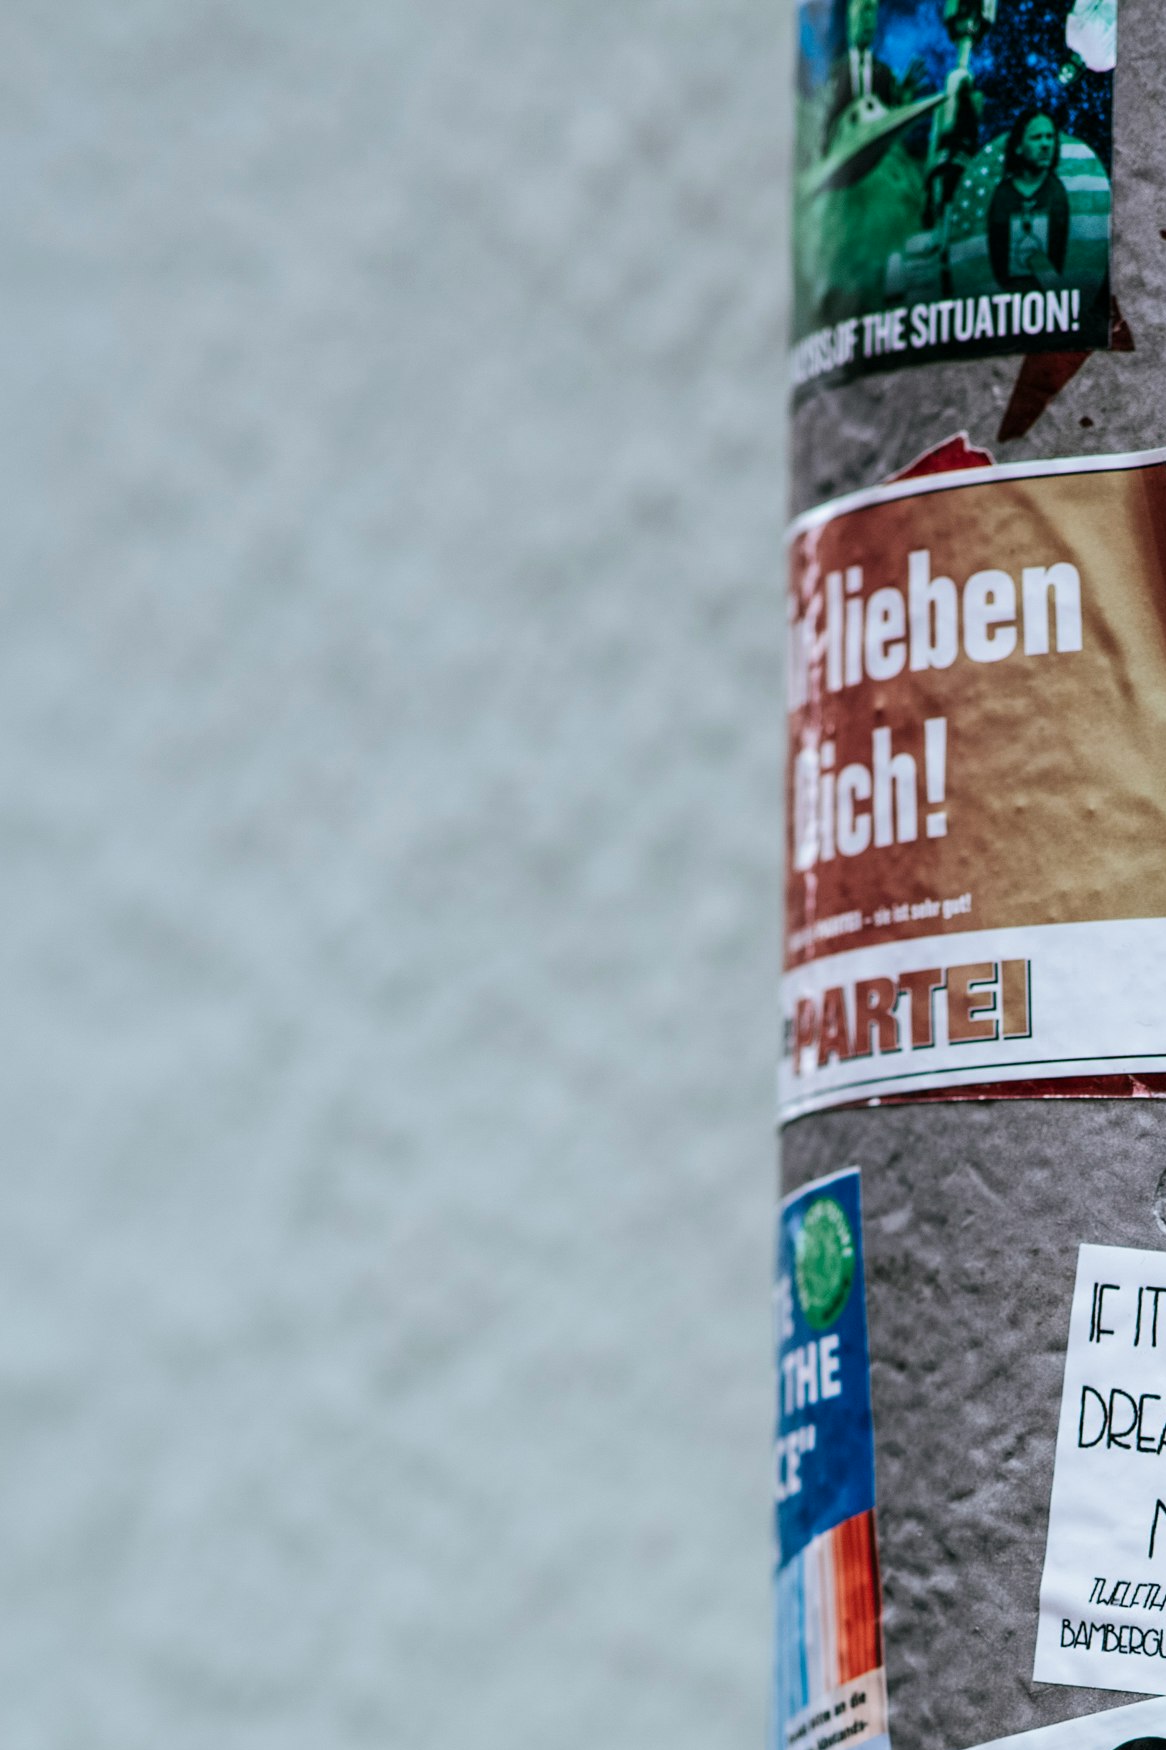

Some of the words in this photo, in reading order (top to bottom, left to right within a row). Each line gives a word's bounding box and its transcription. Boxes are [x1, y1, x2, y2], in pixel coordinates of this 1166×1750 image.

[862, 306, 908, 358] THE
[910, 288, 1081, 349] SITUATION!
[826, 549, 1083, 693] lieben
[793, 958, 1033, 1077] PARTEI
[1090, 1282, 1120, 1344] IF
[782, 1334, 841, 1416] THE
